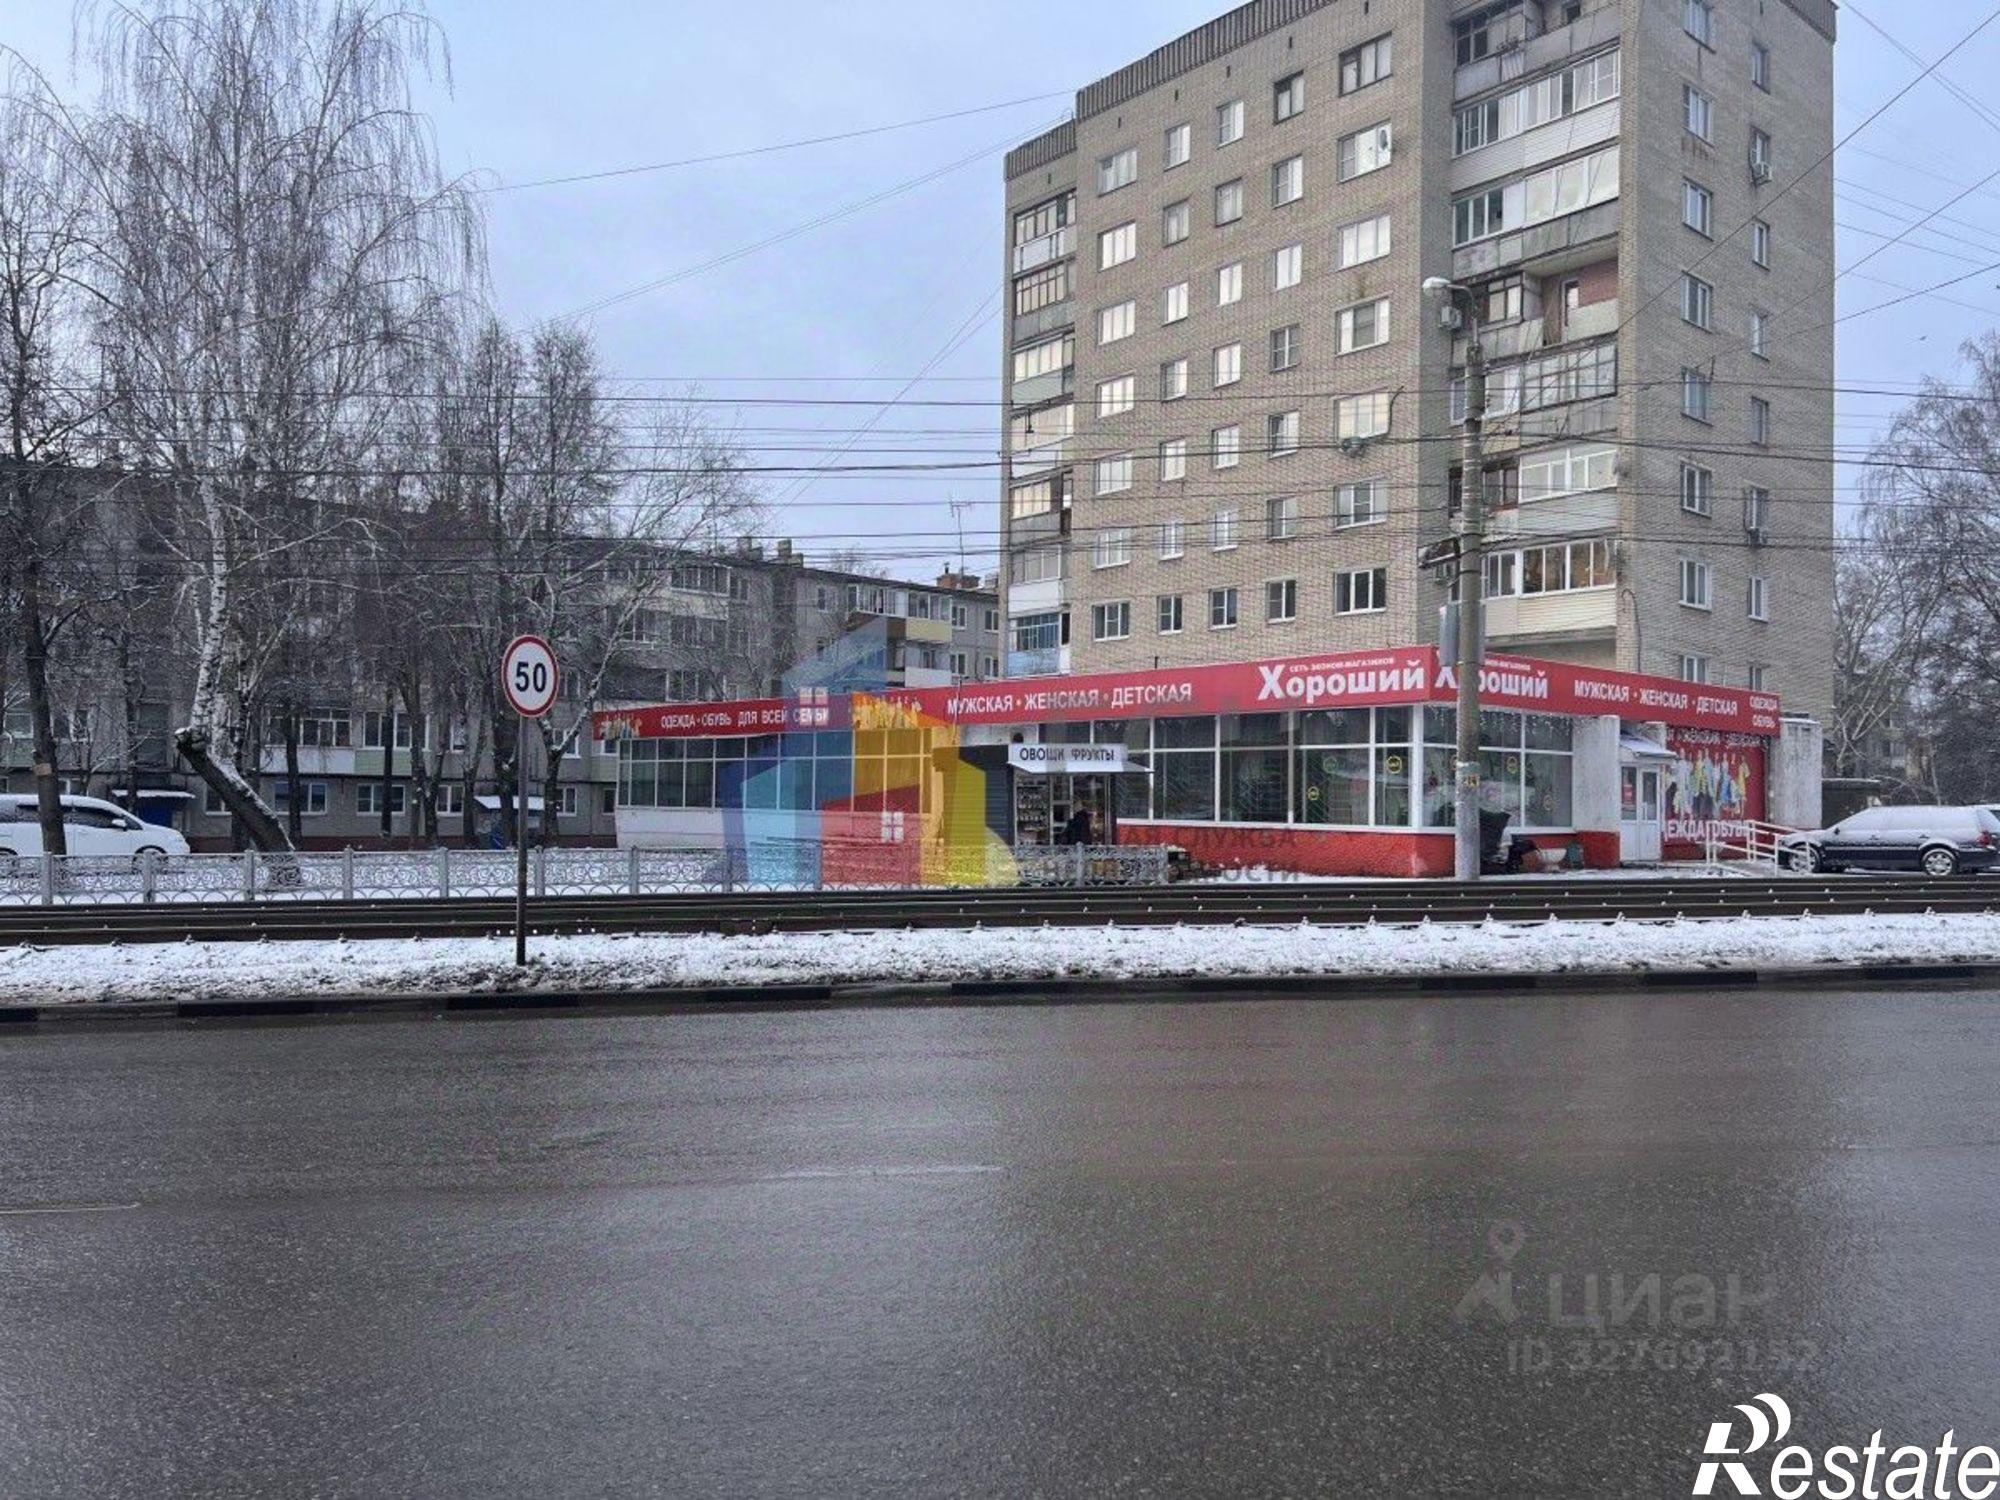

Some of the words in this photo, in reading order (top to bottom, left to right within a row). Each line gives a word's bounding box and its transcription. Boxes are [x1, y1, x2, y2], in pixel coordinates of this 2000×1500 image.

[515, 661, 547, 693] 50
[1258, 659, 1425, 704] Хороший
[947, 693, 1014, 715] МУЖСКАЯ
[1024, 689, 1100, 711] ЖЕНСКАЯ
[1110, 682, 1193, 707] ДЕТСКАЯ
[1574, 680, 1630, 702] МУЖСКАЯ
[1640, 688, 1689, 709] ЖЕНСКАЯ
[1696, 697, 1738, 716] ДЕТСКАЯ
[660, 715, 696, 729] ОДЕЖДА
[701, 714, 733, 727] ОБУВЬ
[737, 711, 758, 726] ДЛЯ
[761, 705, 788, 724] ВСЕЙ
[1020, 748, 1065, 761] ОВОЩИ
[1071, 749, 1115, 761] ФРУКТЫ
